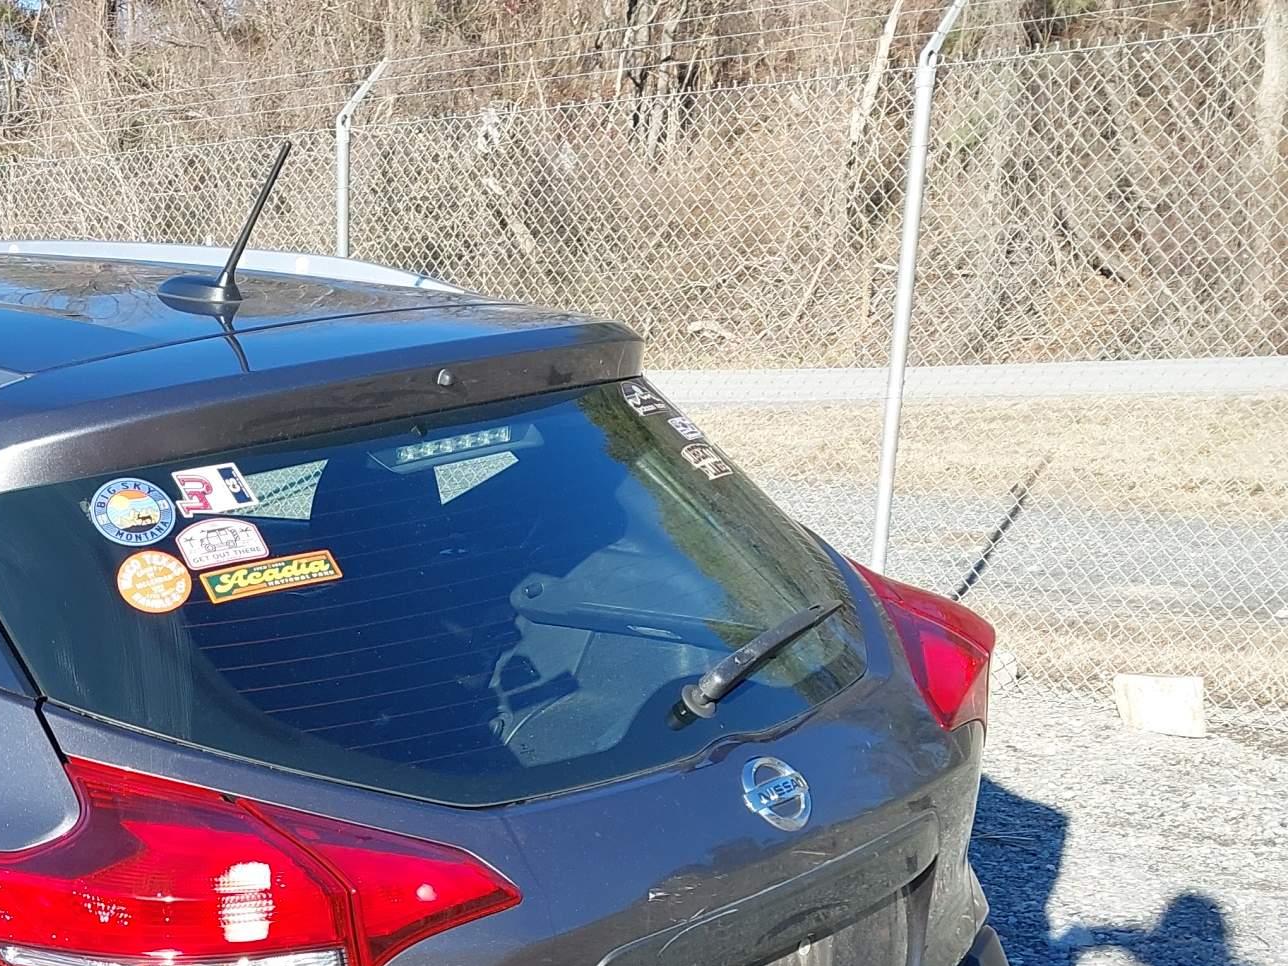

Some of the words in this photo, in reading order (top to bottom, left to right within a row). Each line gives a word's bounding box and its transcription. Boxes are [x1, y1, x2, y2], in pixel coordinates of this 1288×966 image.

[97, 488, 116, 508] BIG
[121, 482, 155, 494] SKY
[115, 521, 169, 542] MONTANA
[193, 556, 210, 564] GET
[212, 551, 231, 560] OUT
[233, 546, 261, 555] THERE
[215, 559, 330, 593] Acadia
[758, 777, 807, 802] NISSAN
